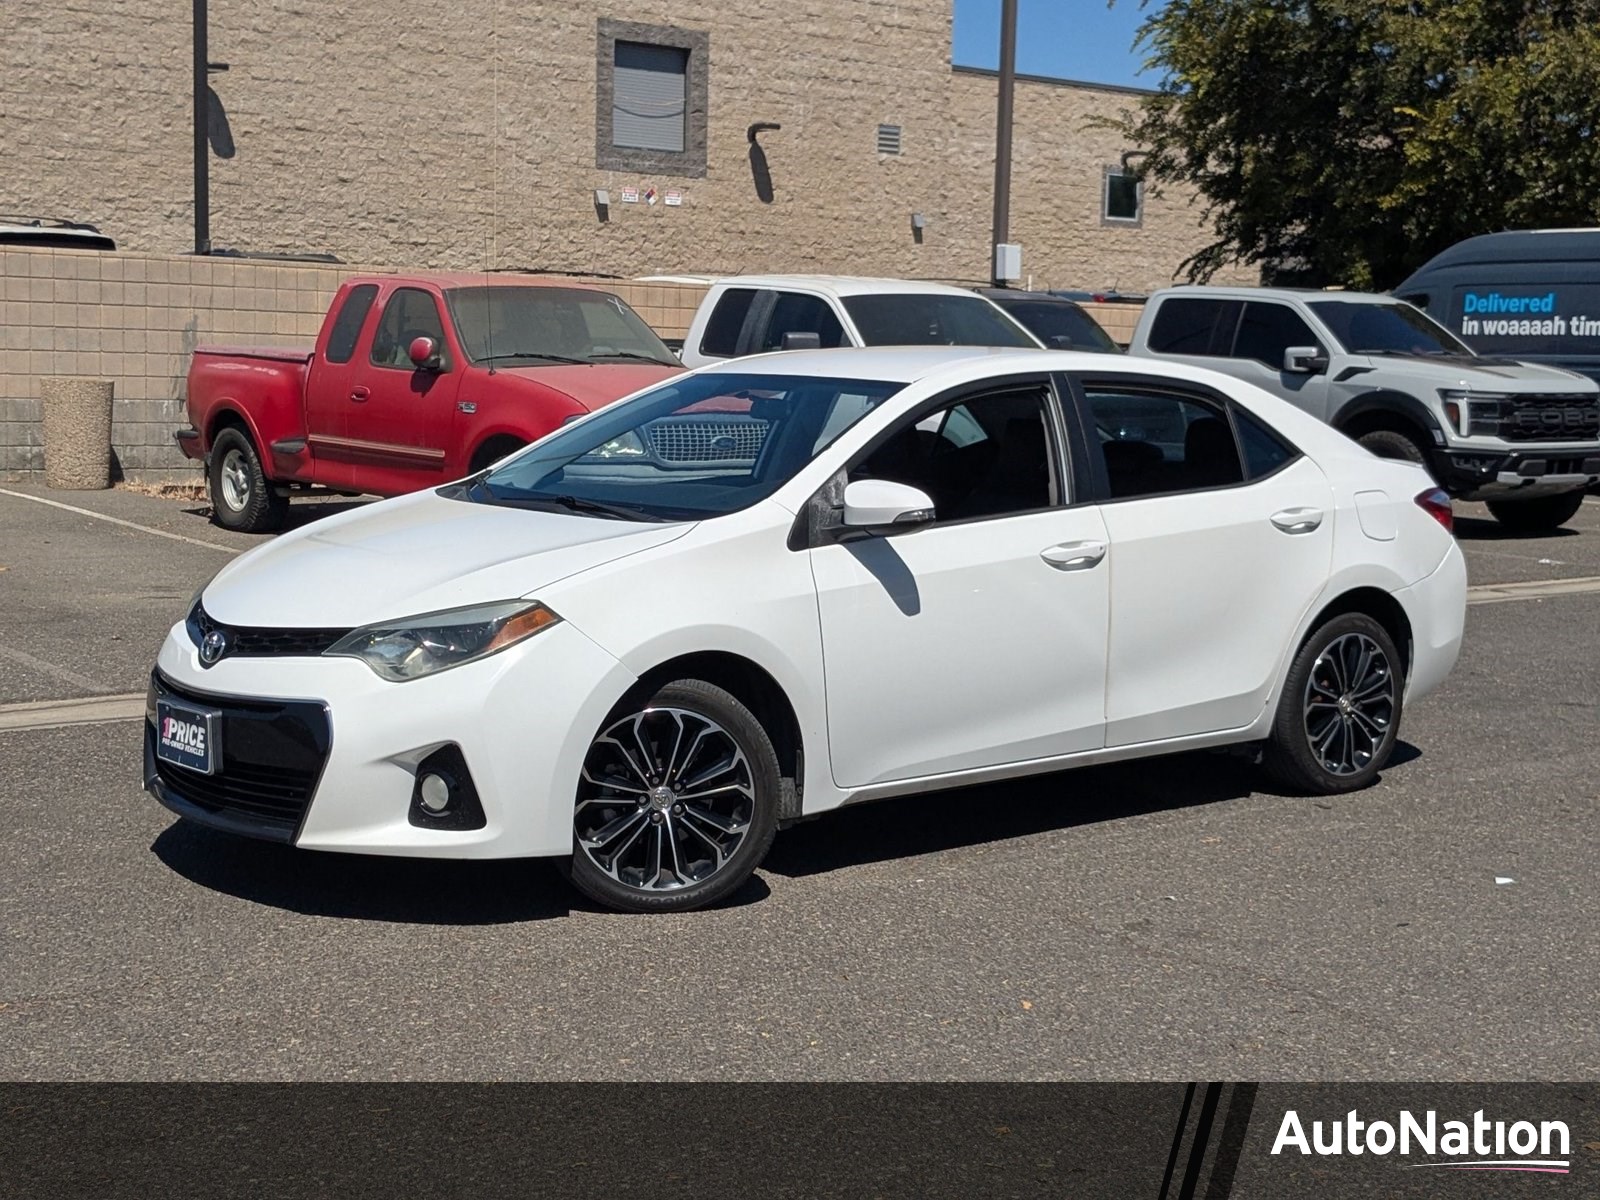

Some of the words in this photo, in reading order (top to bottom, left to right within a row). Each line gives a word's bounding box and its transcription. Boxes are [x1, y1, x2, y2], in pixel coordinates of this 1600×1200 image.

[1464, 293, 1554, 313] Delivered
[1462, 316, 1479, 335] in
[1483, 316, 1565, 335] woaaaah
